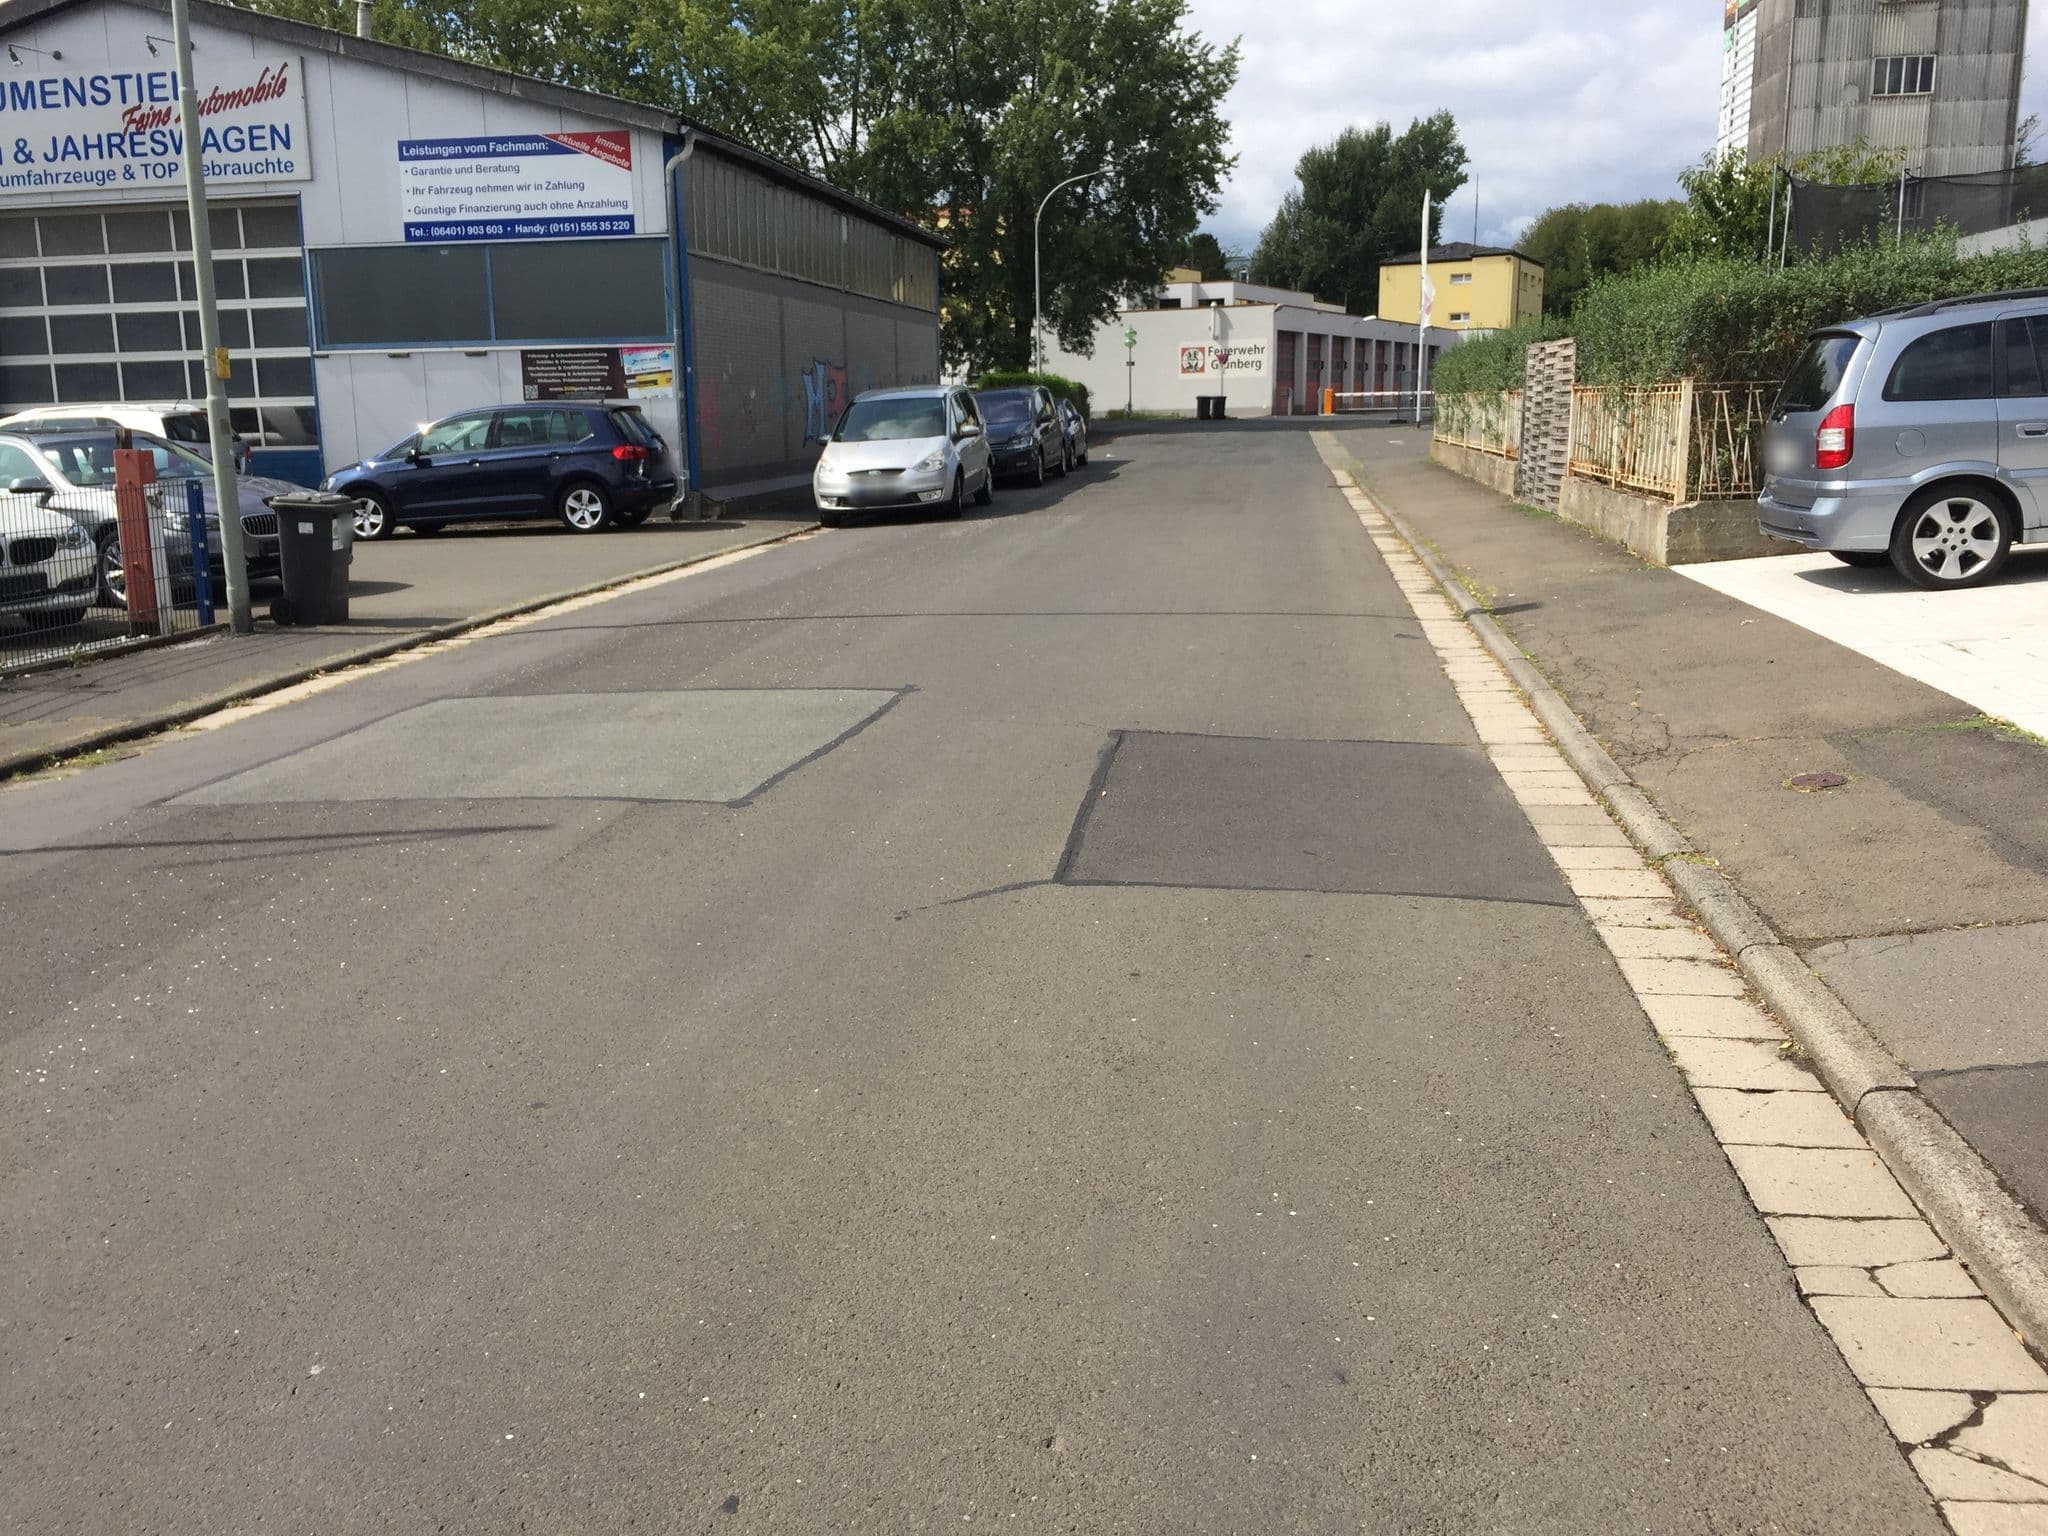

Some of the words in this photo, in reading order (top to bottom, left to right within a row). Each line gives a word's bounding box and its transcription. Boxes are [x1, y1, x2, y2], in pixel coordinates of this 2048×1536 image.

[121, 103, 172, 137] Feine
[175, 62, 288, 123] utomobile
[13, 138, 35, 164] &
[402, 145, 462, 157] Leistungen
[463, 144, 487, 153] vom
[489, 141, 549, 153] Fachmann:
[557, 134, 591, 152] aktuelle
[590, 146, 631, 168] Angebote
[595, 135, 625, 153] Immer
[122, 164, 136, 181] &
[140, 162, 179, 180] TOP
[201, 157, 294, 177] ebrauchte
[410, 166, 452, 177] Garantie
[454, 165, 473, 175] und
[475, 164, 521, 175] Beratung
[412, 186, 426, 196] Ihr
[428, 184, 474, 196] Fahrzeug
[475, 183, 514, 193] nehmen
[516, 182, 532, 192] wir
[534, 181, 544, 191] in
[545, 180, 586, 192] Zahlung
[459, 202, 522, 214] Finanzierung
[523, 201, 548, 211] auch
[550, 200, 575, 210] ohne
[577, 198, 629, 210] Anzahlung
[410, 227, 429, 237] Tel.:
[431, 225, 466, 237] (06401)
[466, 225, 485, 236] 903
[486, 224, 503, 235] 603
[515, 223, 548, 235] Handy:
[549, 222, 579, 234] (0151)
[580, 221, 598, 232] 555
[600, 220, 612, 231] 35
[612, 219, 630, 230] 220
[1208, 344, 1265, 356] Feuerwehr
[1211, 359, 1262, 371] Gnberg
